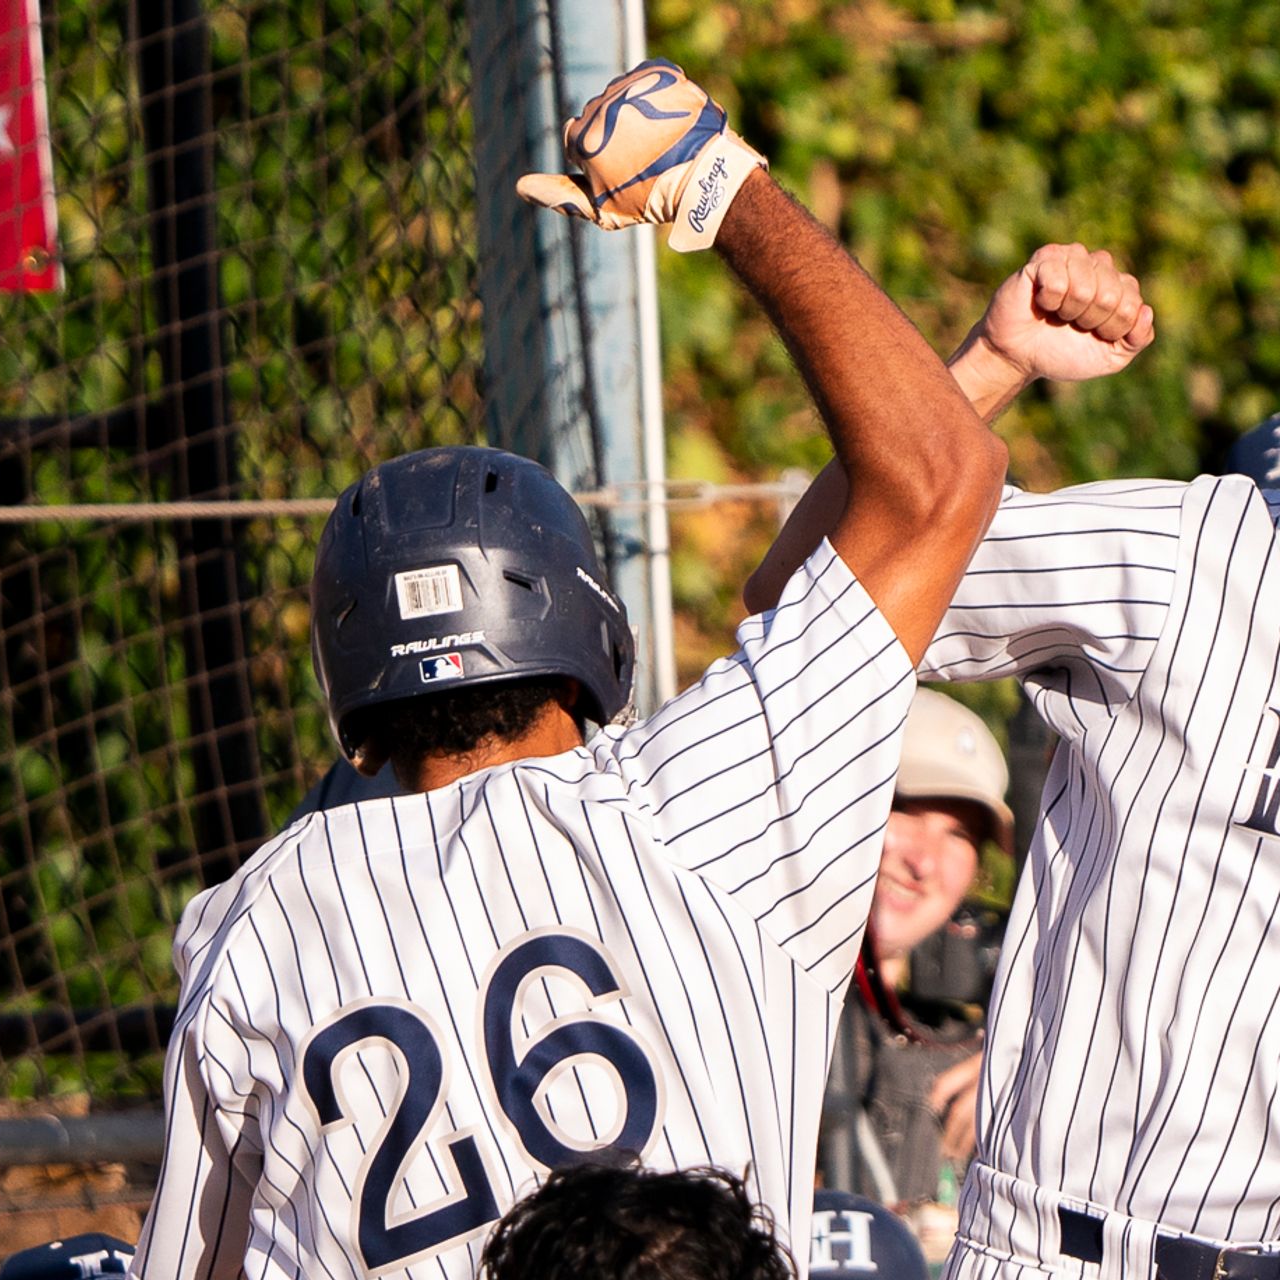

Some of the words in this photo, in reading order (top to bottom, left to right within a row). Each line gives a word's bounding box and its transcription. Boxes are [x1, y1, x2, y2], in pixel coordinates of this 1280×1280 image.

[688, 157, 728, 233] Rawlings
[391, 630, 486, 657] RAWLINGS
[301, 930, 661, 1274] 26
[810, 1210, 878, 1271] H
